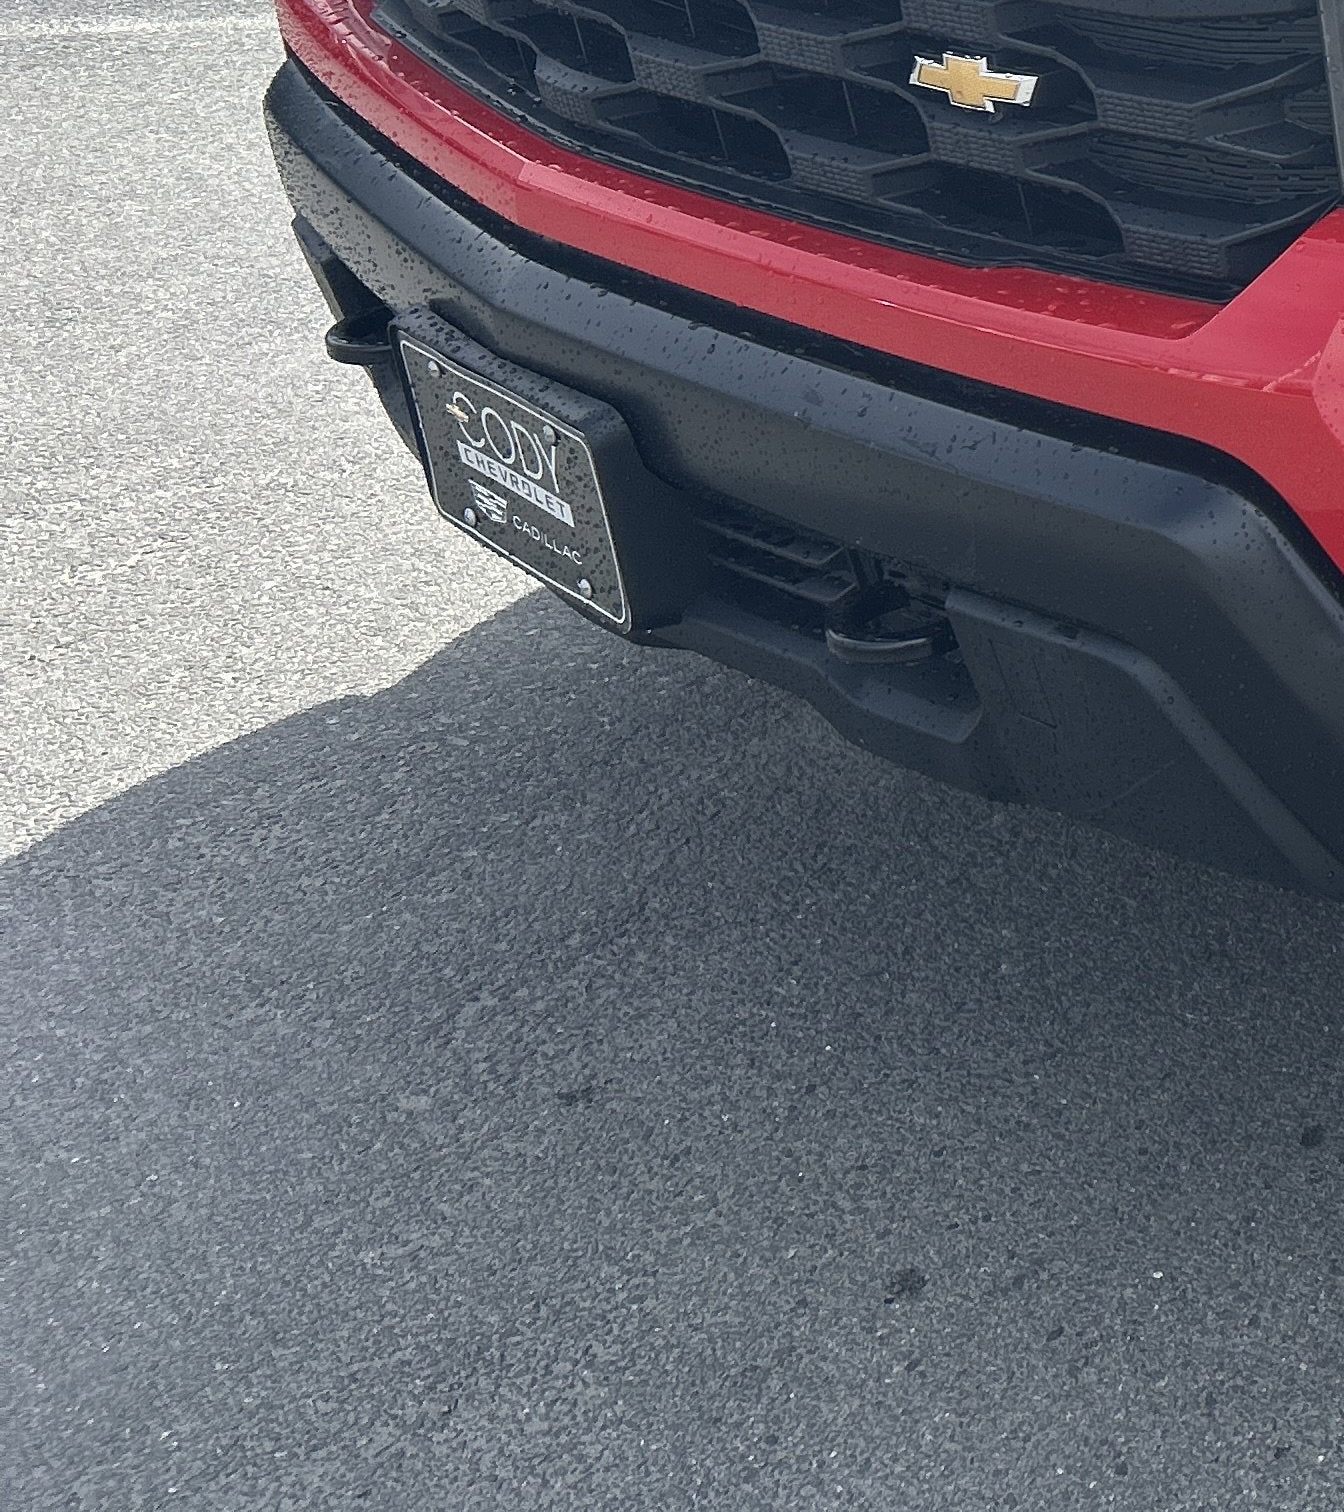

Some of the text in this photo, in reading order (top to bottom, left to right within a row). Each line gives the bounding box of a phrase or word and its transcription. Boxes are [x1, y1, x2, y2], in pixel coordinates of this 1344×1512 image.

[450, 391, 560, 493] CODY
[462, 448, 569, 522] CHEVROLET
[512, 515, 583, 566] CADILLAC
